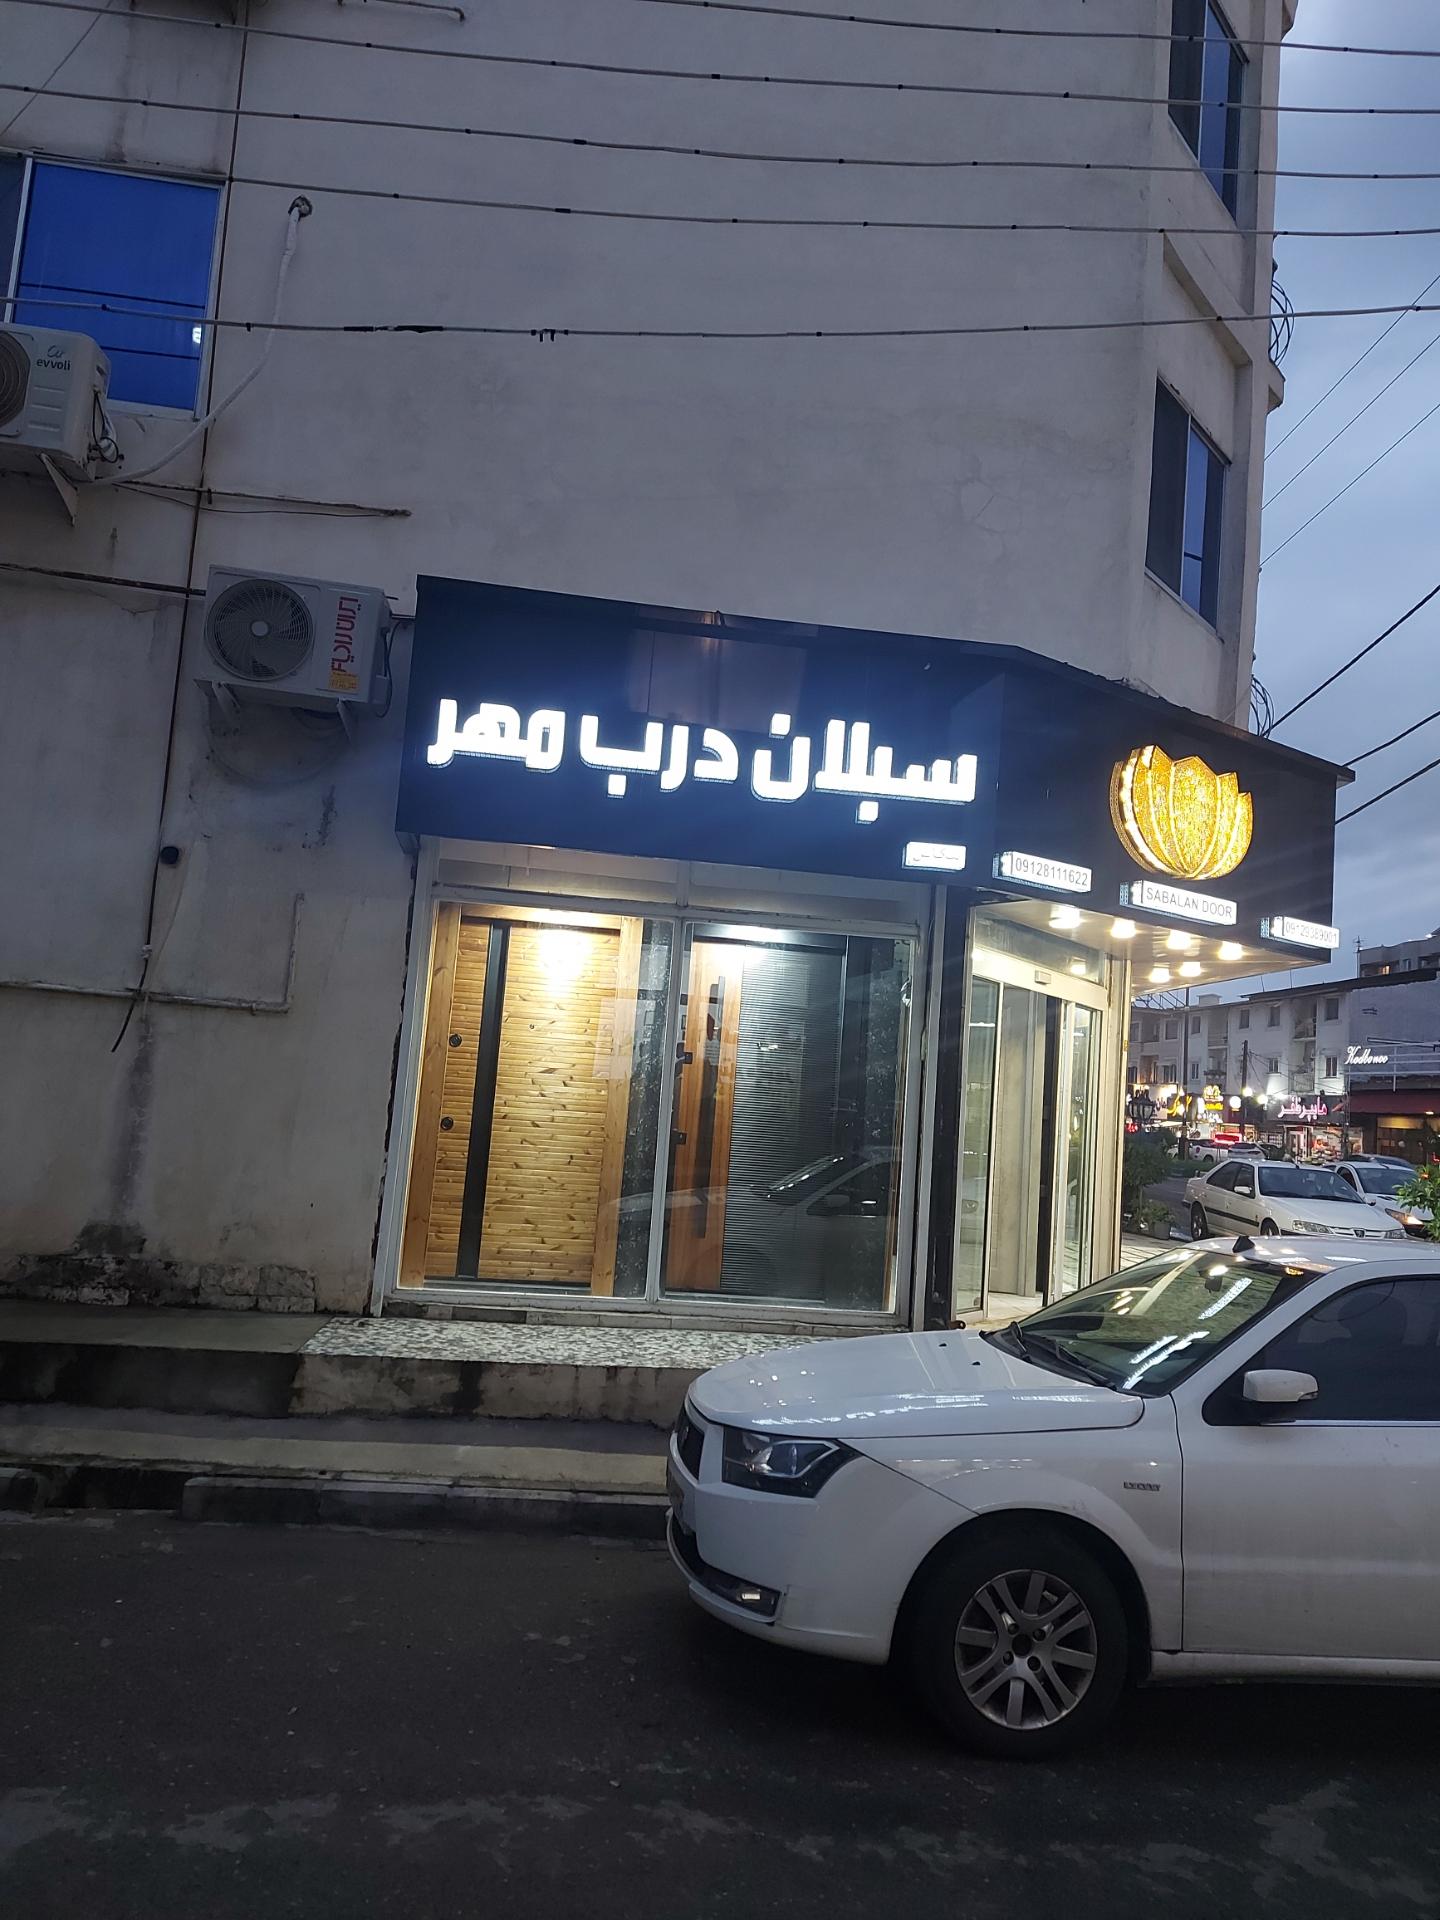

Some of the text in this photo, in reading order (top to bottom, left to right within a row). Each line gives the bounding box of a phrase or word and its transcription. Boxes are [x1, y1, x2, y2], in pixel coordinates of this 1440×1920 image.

[36, 359, 71, 371] evvoli
[426, 697, 978, 825] سبلان درب مهر
[1015, 857, 1089, 887] 09128111622
[1146, 887, 1233, 919] SABALAN DOOR
